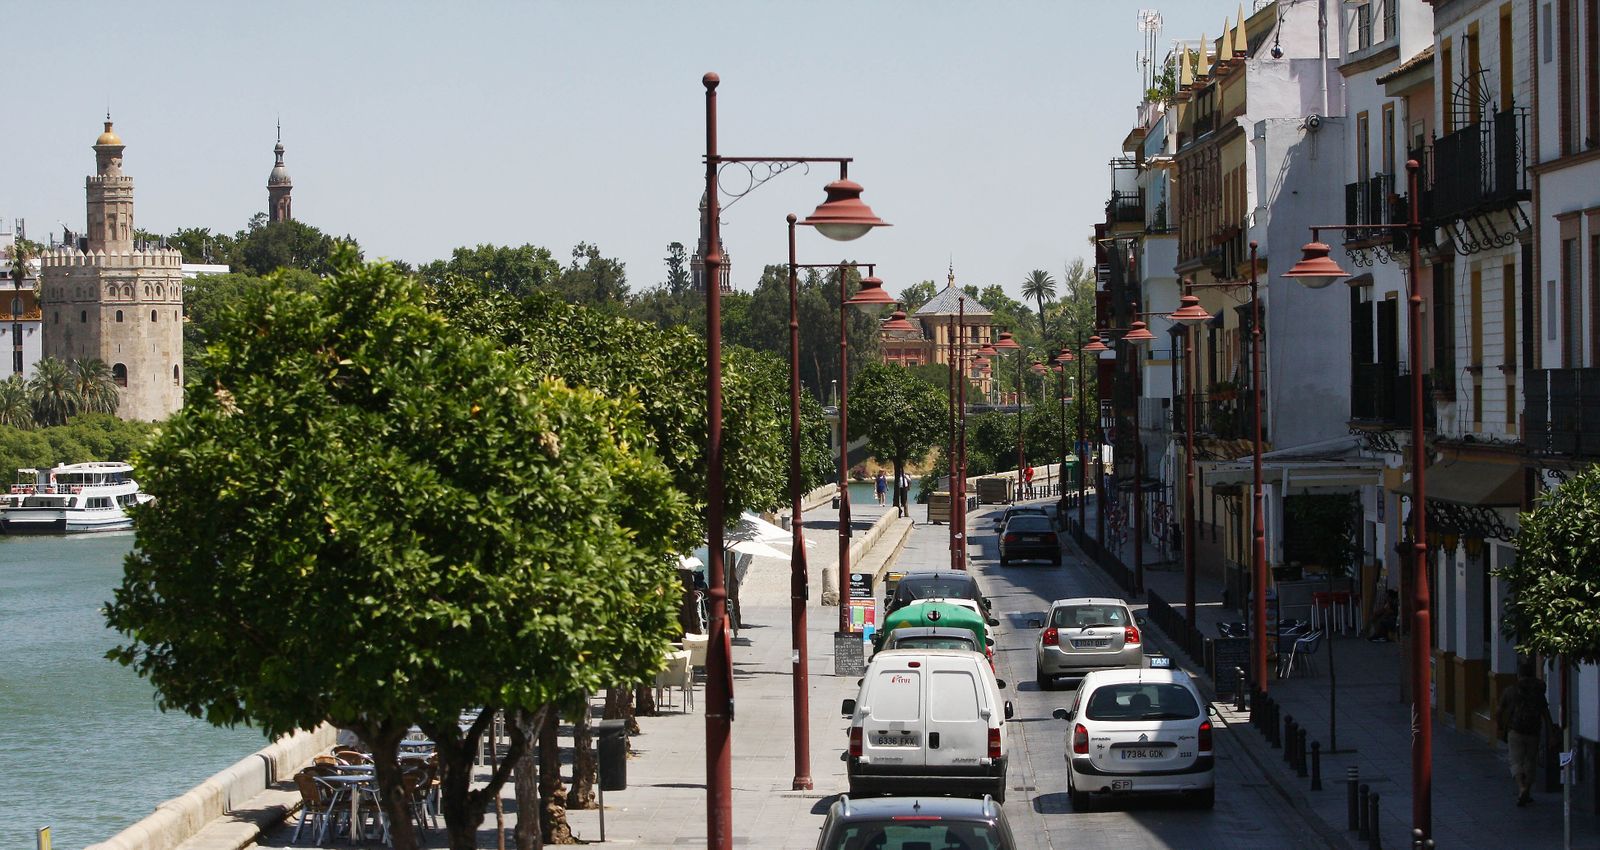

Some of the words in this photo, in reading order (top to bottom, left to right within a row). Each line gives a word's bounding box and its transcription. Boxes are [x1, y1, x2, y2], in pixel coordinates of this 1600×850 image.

[1152, 657, 1170, 665] TAXI
[878, 737, 897, 745] 6336
[900, 737, 915, 745] FXX
[1127, 750, 1146, 758] 7384
[1115, 781, 1130, 789] SP
